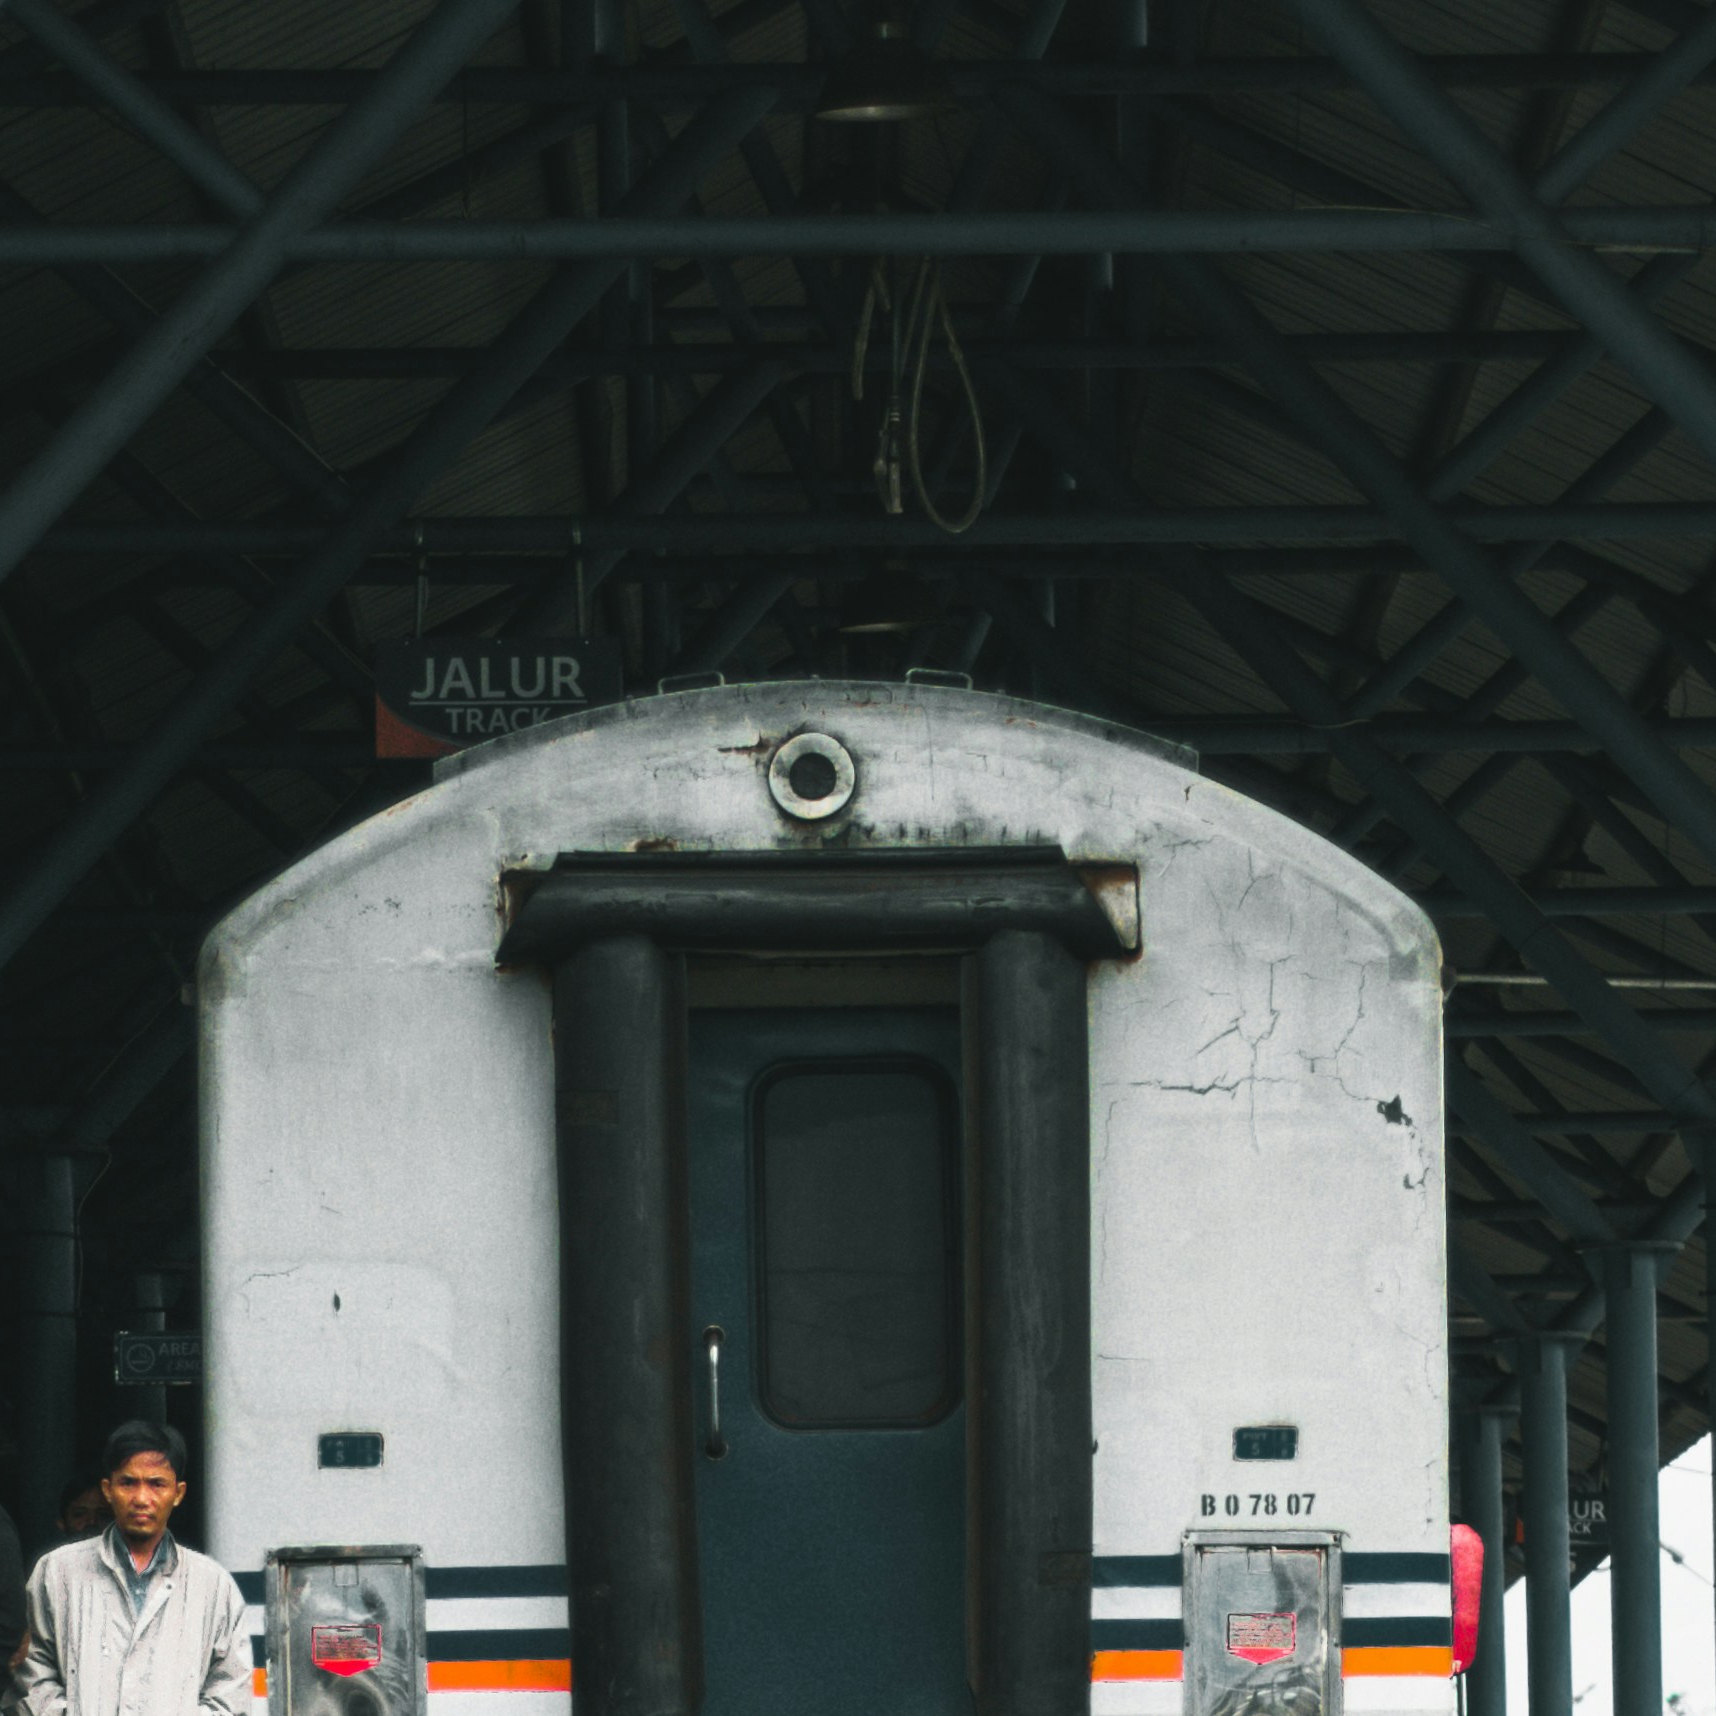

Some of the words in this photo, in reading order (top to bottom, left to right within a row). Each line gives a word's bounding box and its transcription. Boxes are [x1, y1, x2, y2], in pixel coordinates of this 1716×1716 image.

[411, 656, 585, 700] JALUR
[1201, 1494, 1216, 1516] B
[1249, 1493, 1277, 1515] 78
[1287, 1493, 1316, 1515] 07
